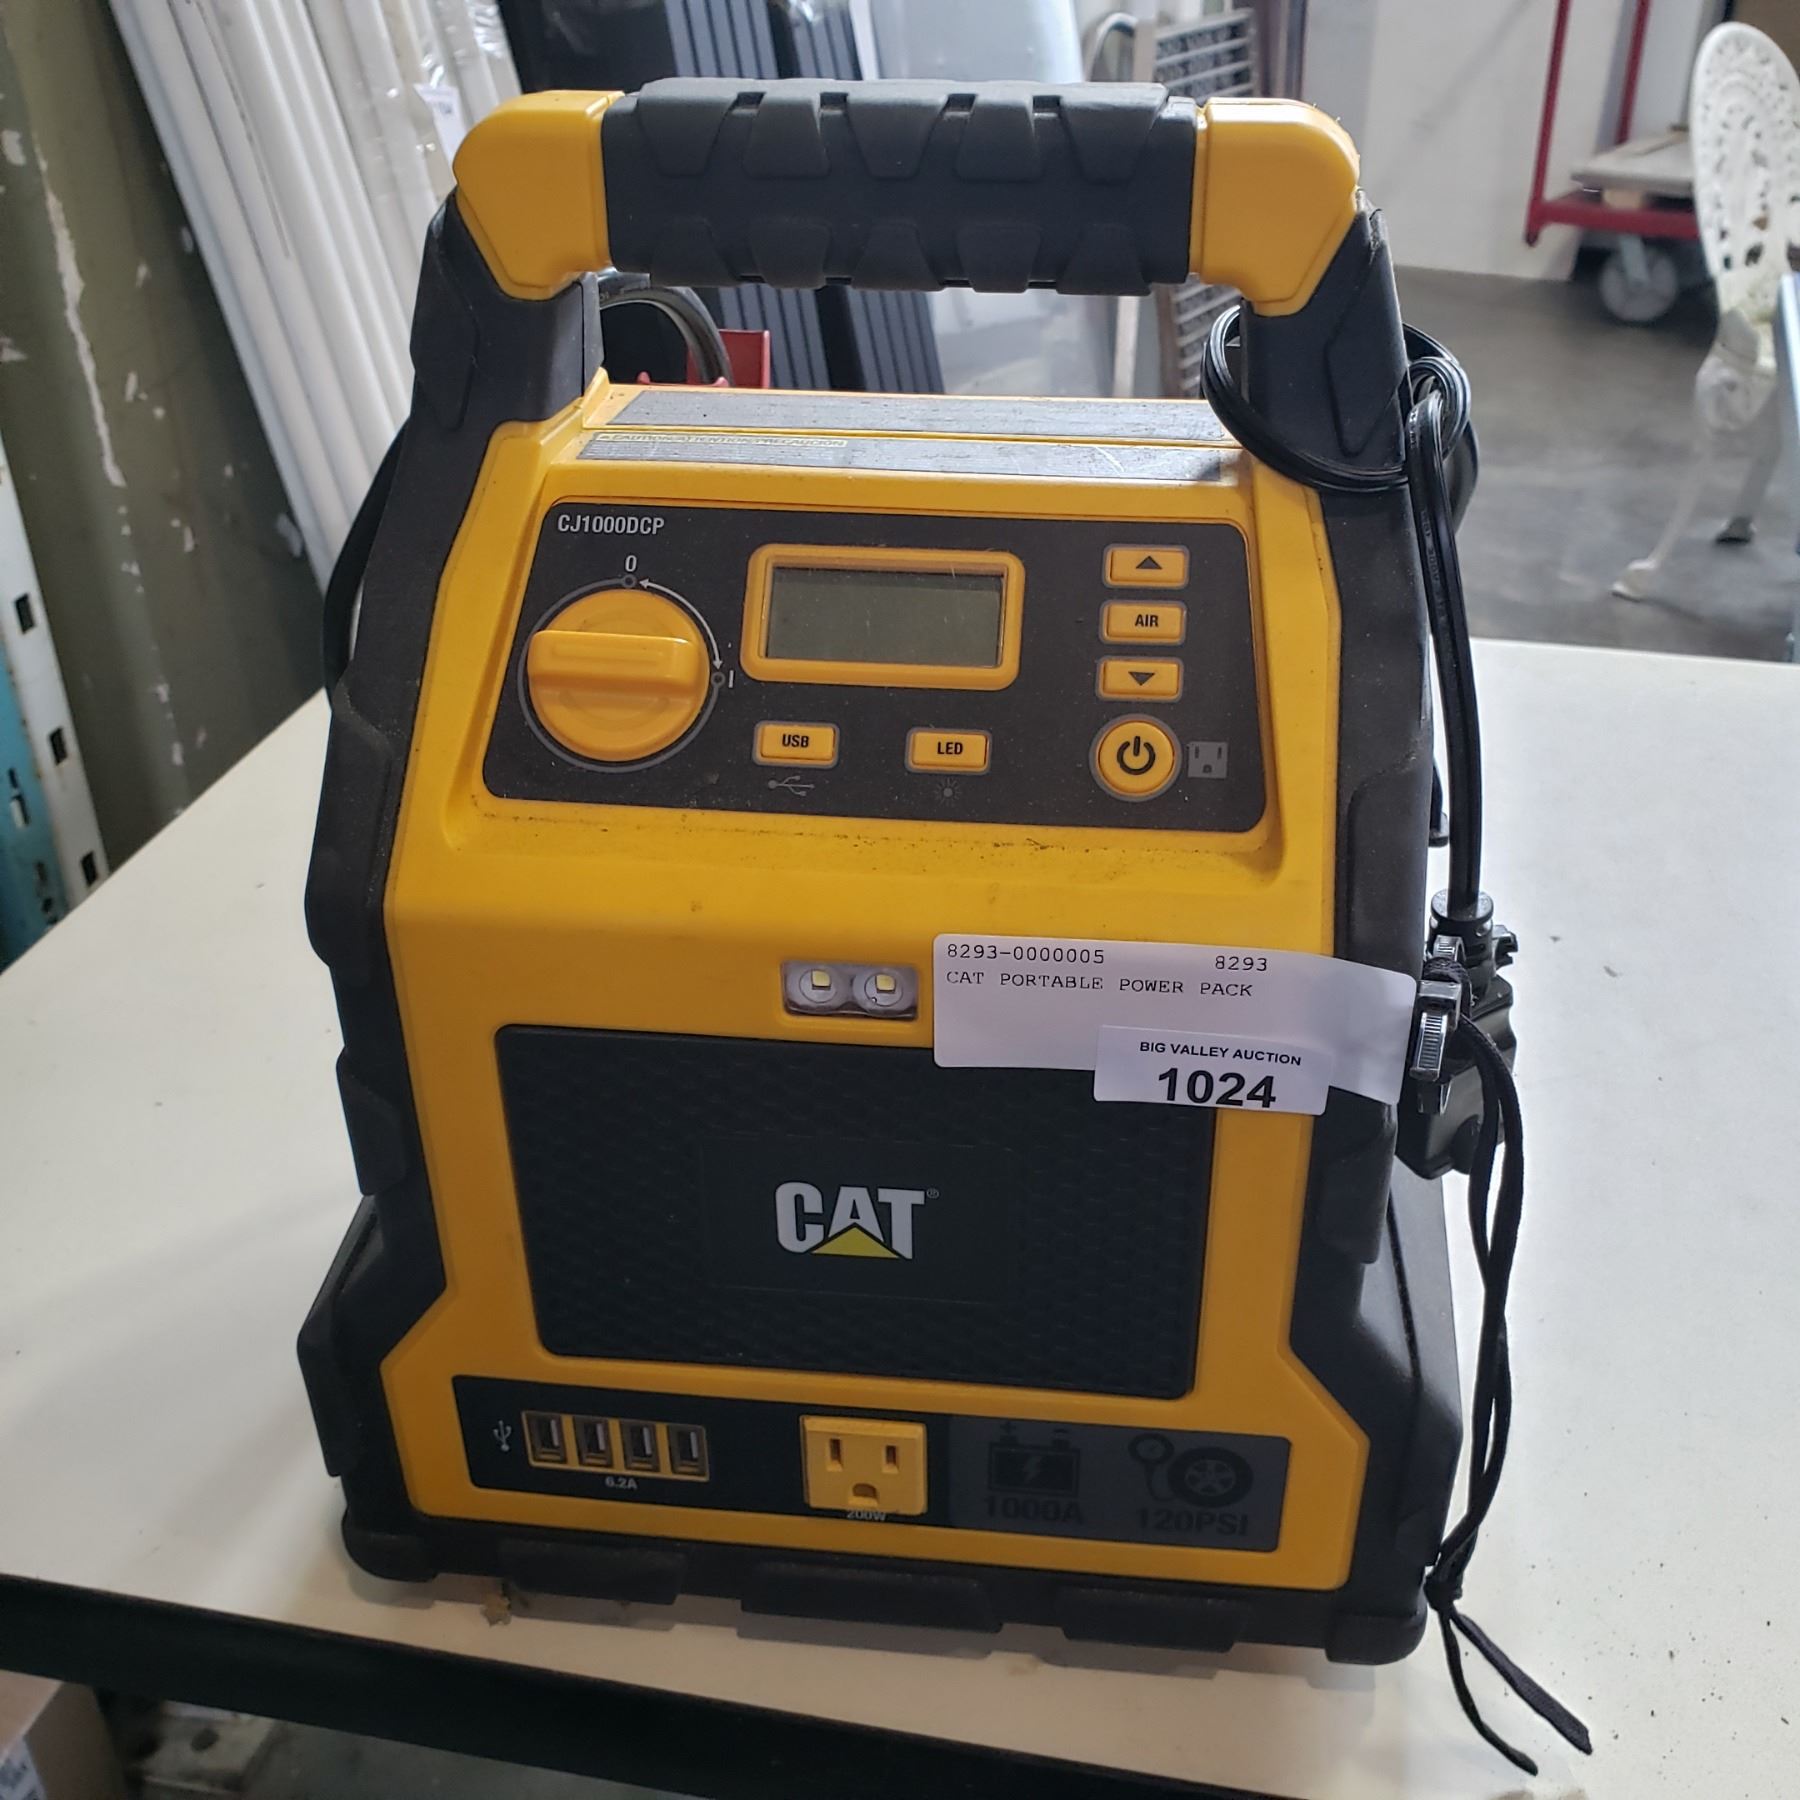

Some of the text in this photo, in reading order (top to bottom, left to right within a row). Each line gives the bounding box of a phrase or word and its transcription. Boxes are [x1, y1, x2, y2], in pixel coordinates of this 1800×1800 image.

[557, 514, 665, 535] CJ1000DCP
[1134, 613, 1159, 628] AIR
[782, 734, 810, 749] USB
[937, 741, 963, 756] LED
[947, 943, 1268, 971] 8293-0000005 8293
[946, 971, 1253, 998] CAT PORTABLE POWER PACK
[1140, 1041, 1302, 1066] BIG VALLEY AUCTION
[1158, 1067, 1277, 1109] 1024
[775, 1181, 925, 1260] CAT
[605, 1476, 637, 1490] 6.2A
[985, 1495, 1083, 1524] 1000A
[1136, 1507, 1249, 1537] 120PSI
